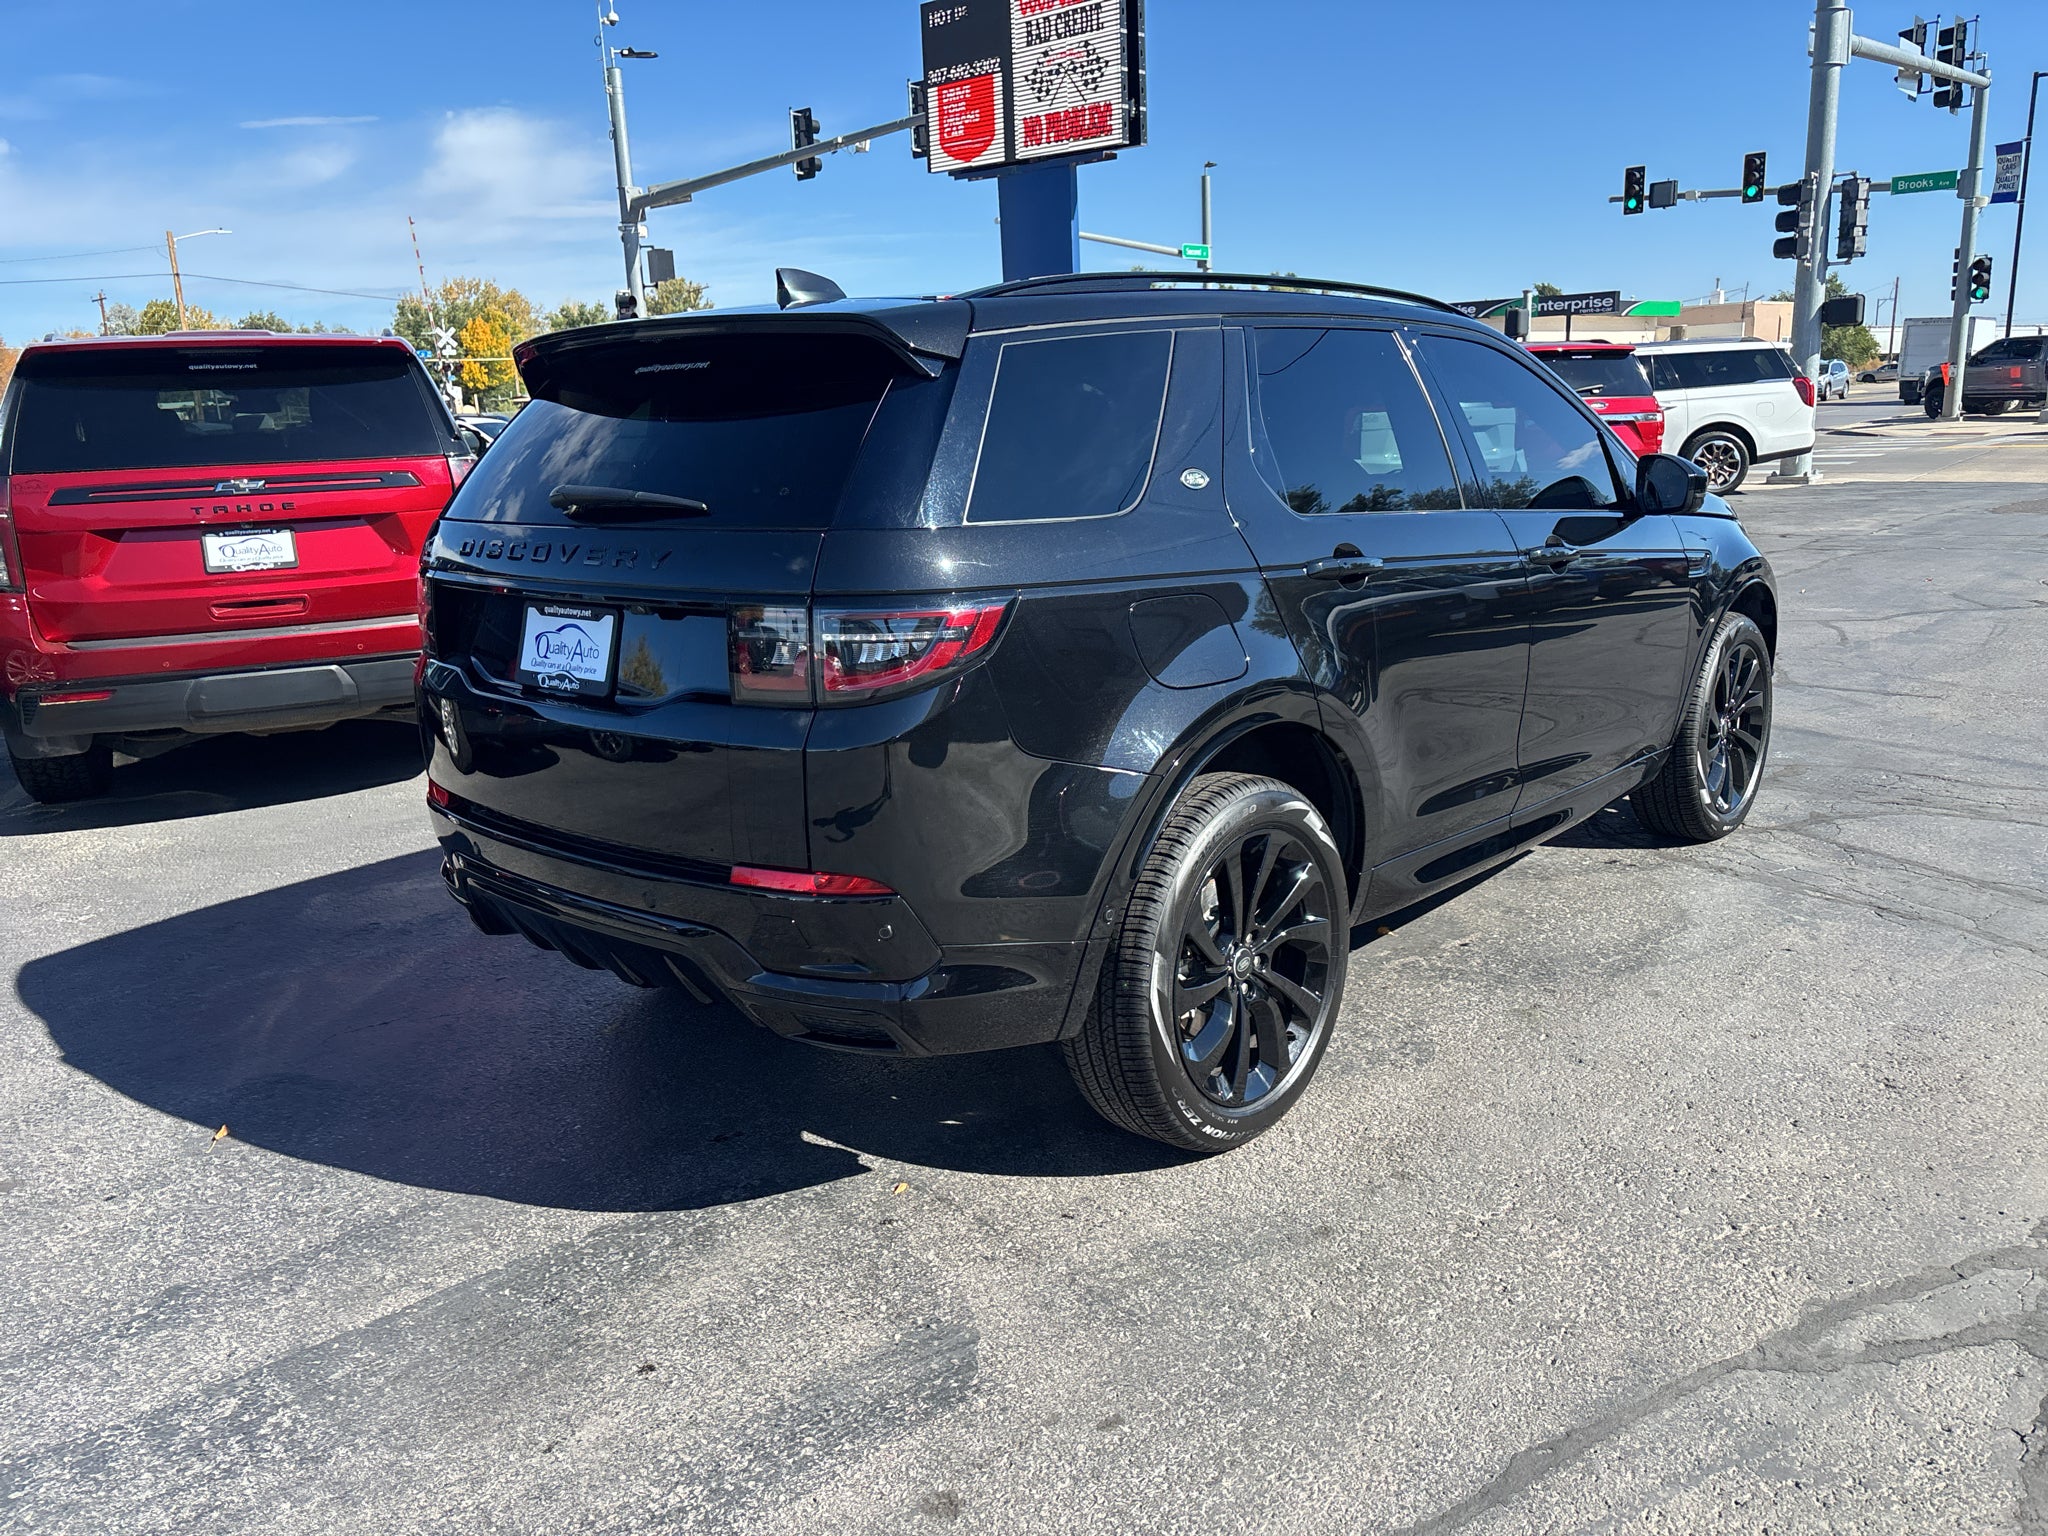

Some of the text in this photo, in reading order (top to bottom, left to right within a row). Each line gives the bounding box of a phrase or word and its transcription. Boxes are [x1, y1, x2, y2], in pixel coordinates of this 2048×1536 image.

[1026, 16, 1051, 46] BAD
[1998, 155, 2021, 165] QUALITY
[1898, 179, 1934, 190] Brooks
[1997, 175, 2019, 184] QUALITY
[1531, 296, 1614, 313] enterprise
[190, 502, 296, 515] TAHOE
[459, 538, 673, 570] DISCOVERY
[544, 605, 592, 618] qualityautowy.net
[531, 658, 547, 669] Quality
